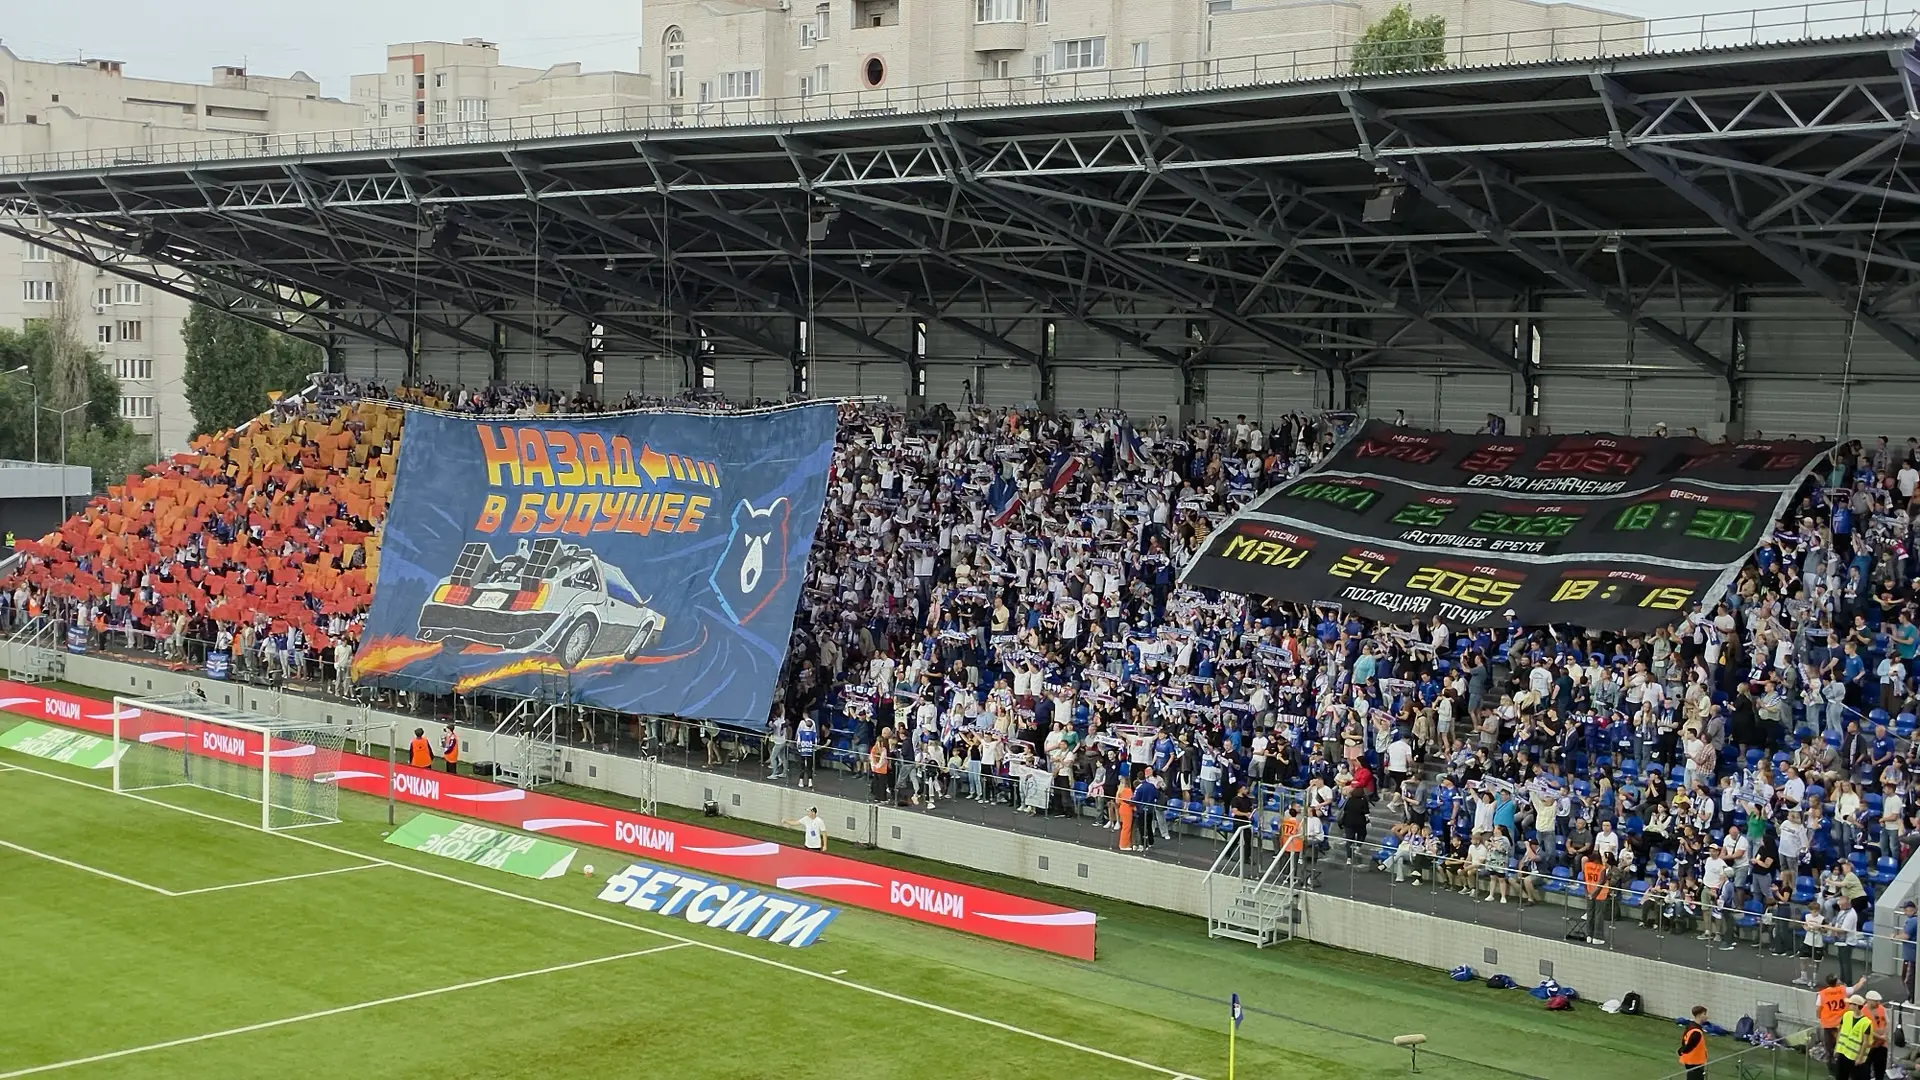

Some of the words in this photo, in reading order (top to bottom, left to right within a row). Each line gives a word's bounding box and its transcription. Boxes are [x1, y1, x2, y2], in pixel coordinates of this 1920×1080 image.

[476, 424, 642, 488] НАЗАД
[1594, 439, 1617, 448] ГОД
[1459, 451, 1517, 473] 25
[1535, 450, 1641, 475] 2024
[1526, 476, 1627, 494] НАЗНАЧЕНИЯ
[1669, 489, 1709, 503] ВРЕМЯ
[475, 494, 507, 534] В
[509, 492, 711, 537] БУДУЩЕЕ
[1468, 511, 1583, 536] 2025
[1264, 529, 1299, 544] МЕСЯЦ
[1360, 550, 1385, 561] ДЕНЬ
[1472, 565, 1498, 576] ГОД
[1608, 571, 1647, 581] ВРЕМЯ
[1489, 539, 1546, 552] ВРЕМЯ
[1327, 555, 1391, 585] 24
[1406, 567, 1521, 606] 2025
[1340, 586, 1432, 613] ПОСЛЕДНЯЯ
[45, 698, 81, 721] БОЧКАРИ
[203, 731, 245, 757] БОЧКАРИ
[615, 820, 674, 853] БОЧКАРИ
[597, 863, 833, 948] БЕТСИТИ
[890, 880, 964, 919] БОЧКАРИ
[1826, 999, 1845, 1011] 124
